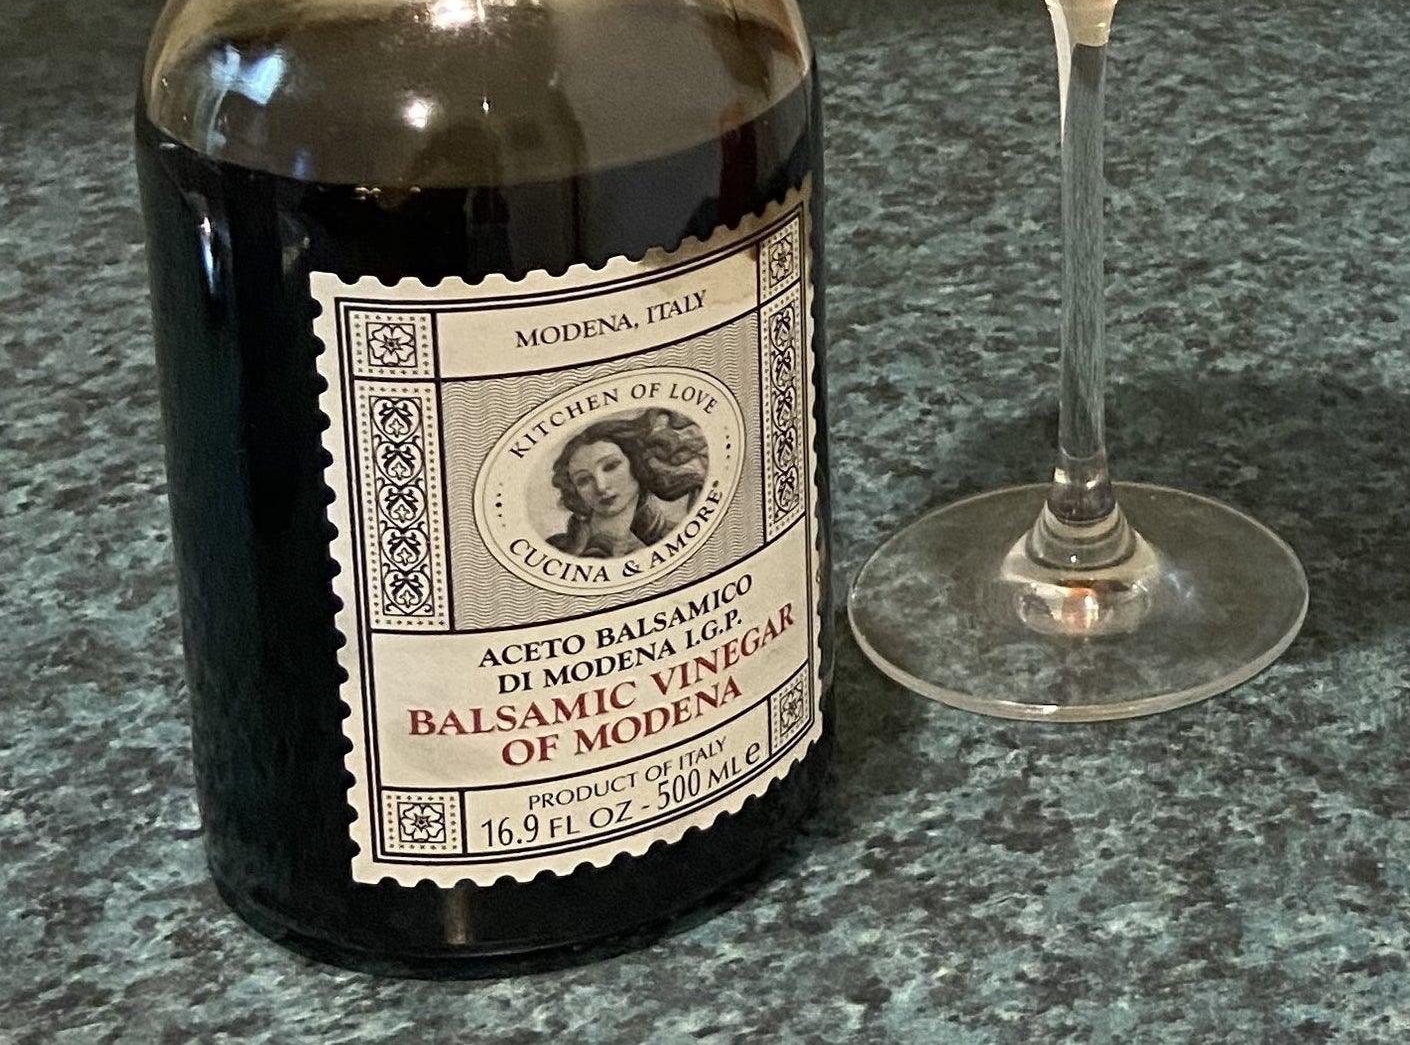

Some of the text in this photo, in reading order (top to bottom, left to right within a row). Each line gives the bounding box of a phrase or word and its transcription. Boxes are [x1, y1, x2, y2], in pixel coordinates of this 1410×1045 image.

[515, 289, 706, 348] MODENA, ITALY
[509, 383, 718, 459] KITCHEN OF LOVE
[509, 489, 723, 582] CUCINA & AMORE
[478, 574, 752, 667] ACETO BALSAMICO
[498, 608, 743, 694] DI MODENA I.G.P.
[407, 603, 794, 736] BALSAMIC VINEGAR
[502, 675, 743, 766] OF MODENA
[481, 813, 539, 847] 16.9
[550, 815, 580, 838] FL
[589, 800, 633, 829] OZ
[657, 768, 701, 810] 500
[708, 757, 742, 789] ML
[528, 735, 727, 810] PRODUCT OF ITALY
